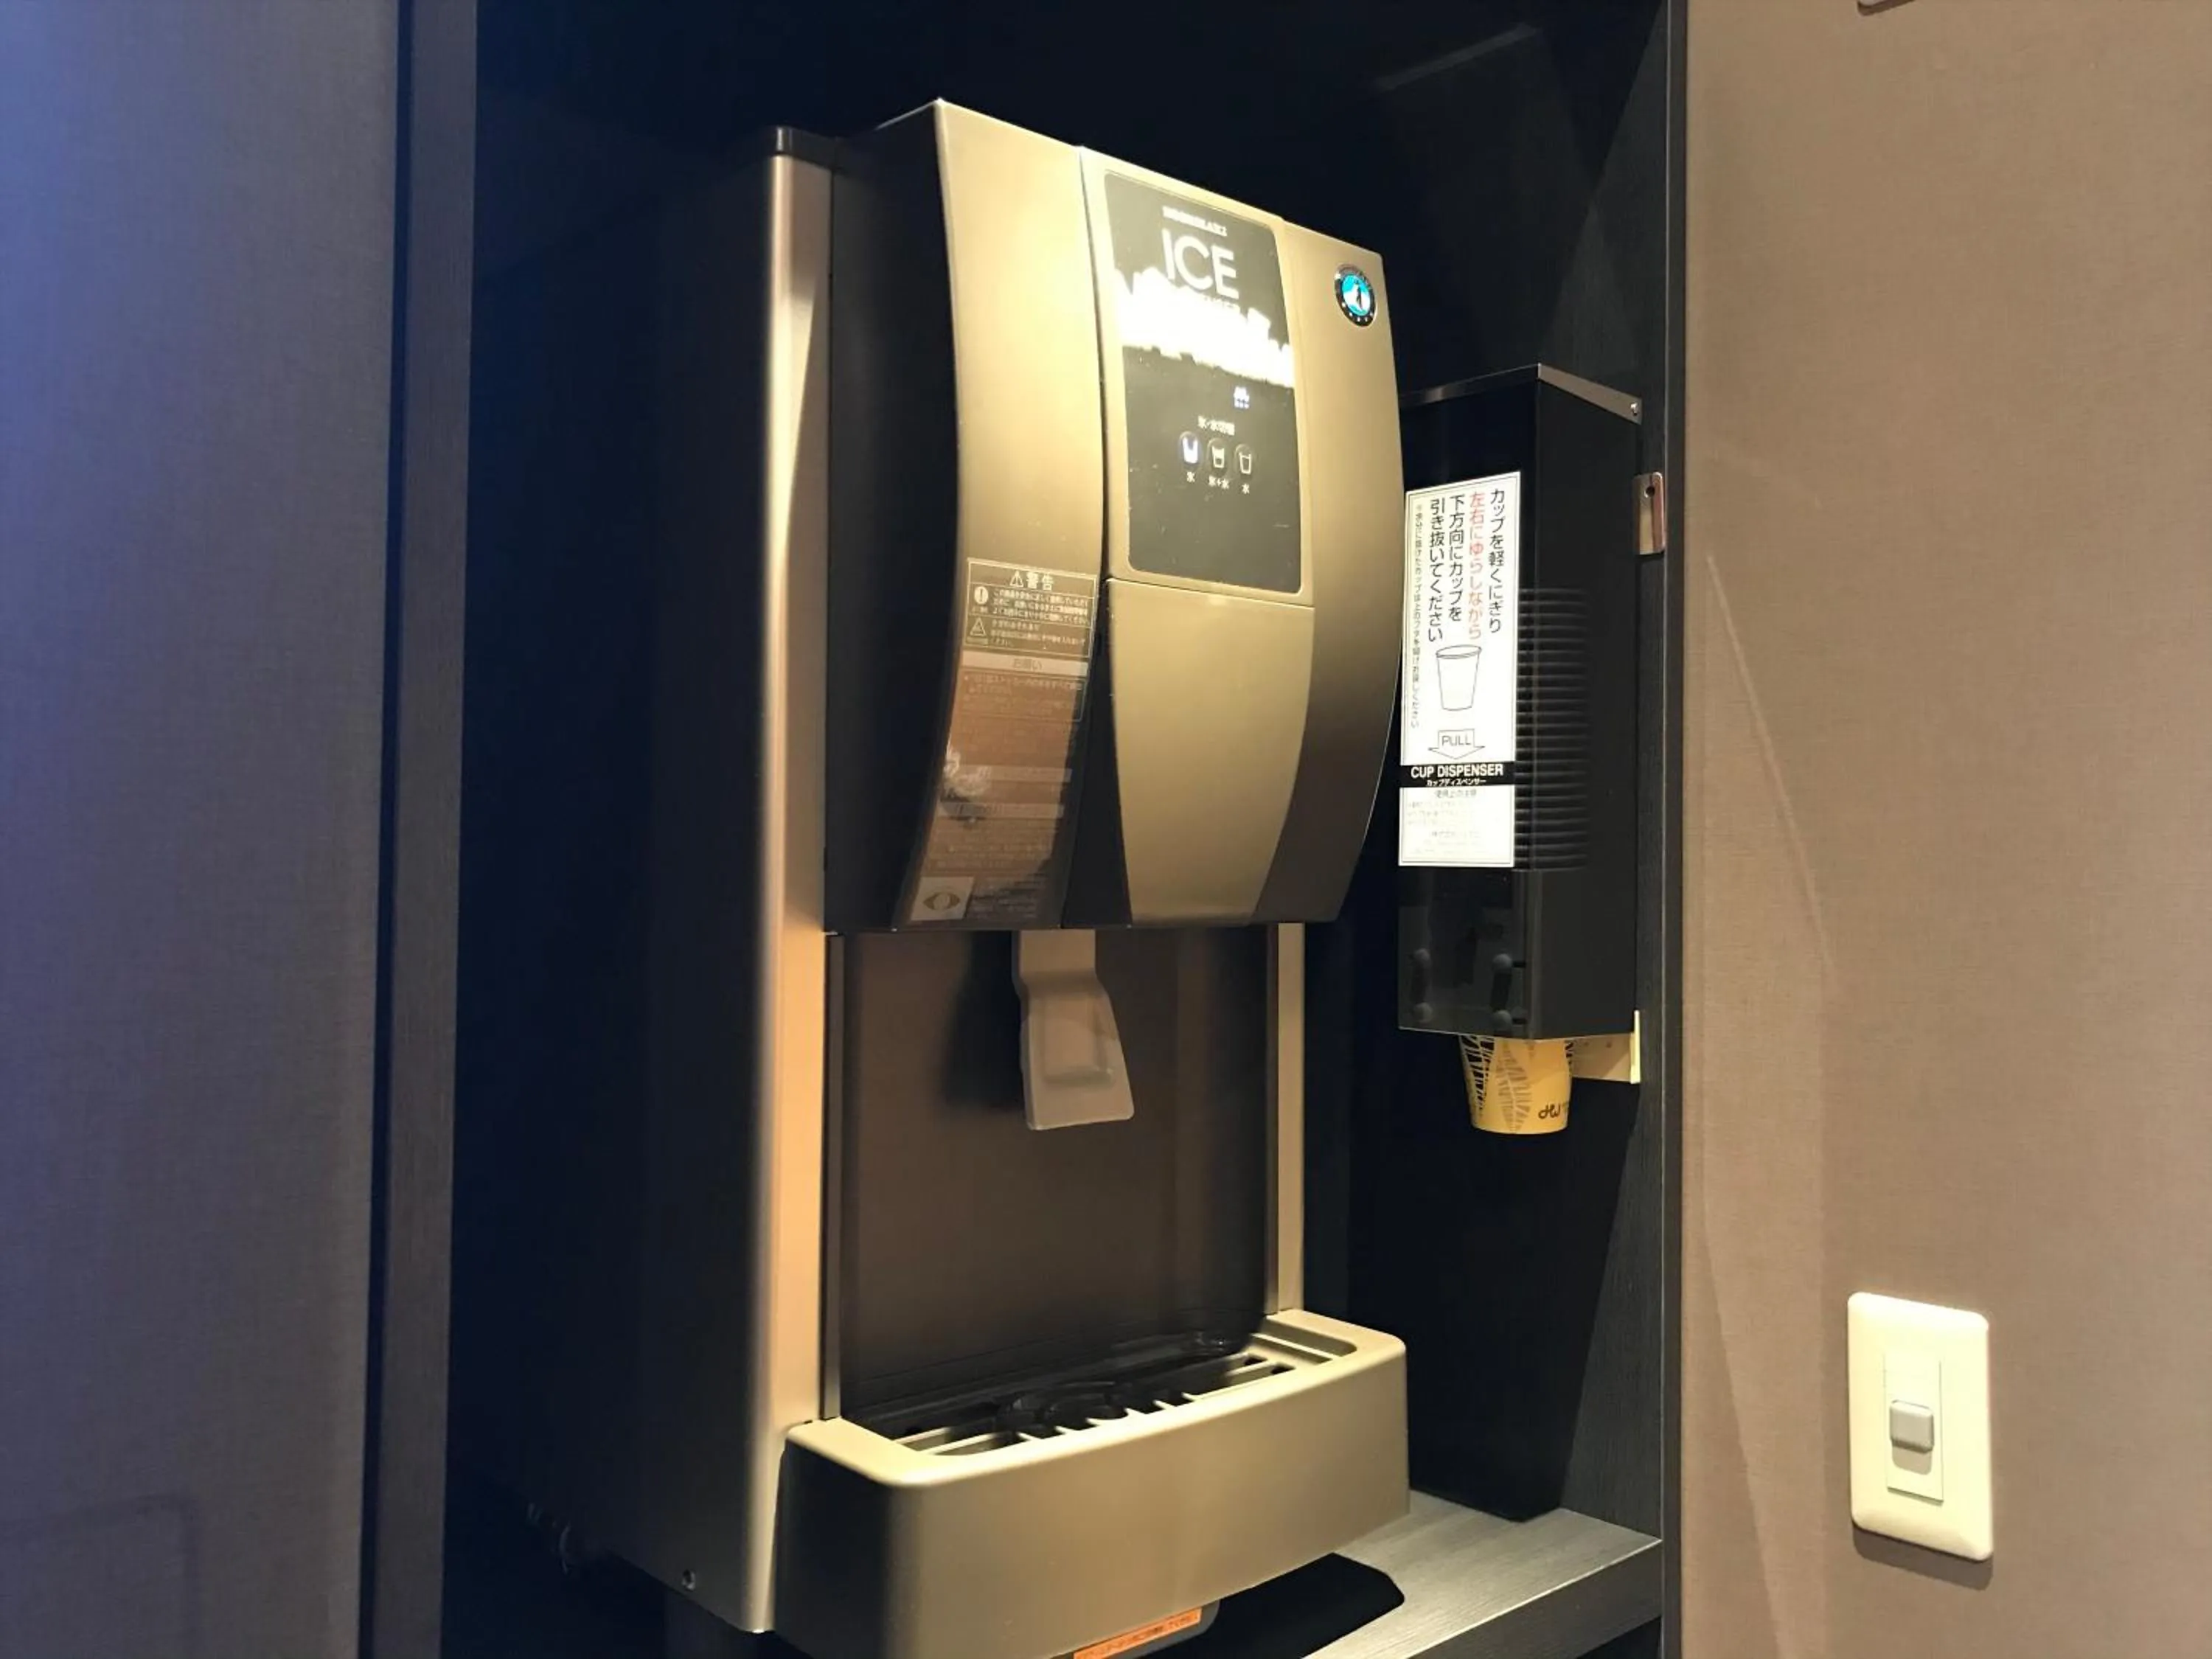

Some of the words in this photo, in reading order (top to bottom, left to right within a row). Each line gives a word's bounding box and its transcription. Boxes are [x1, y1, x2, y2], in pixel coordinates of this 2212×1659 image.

[1162, 228, 1239, 300] ICE
[1026, 571, 1054, 591] 警告
[1427, 497, 1446, 642] 引き抜いてください
[1448, 493, 1466, 622] 下方向にカップを
[1468, 492, 1484, 640] 左右にゆらしながら
[1488, 488, 1505, 633] カップを軽くにぎり
[1411, 765, 1435, 779] CUP
[1437, 763, 1503, 778] DISPENSER
[1441, 734, 1472, 747] PULL
